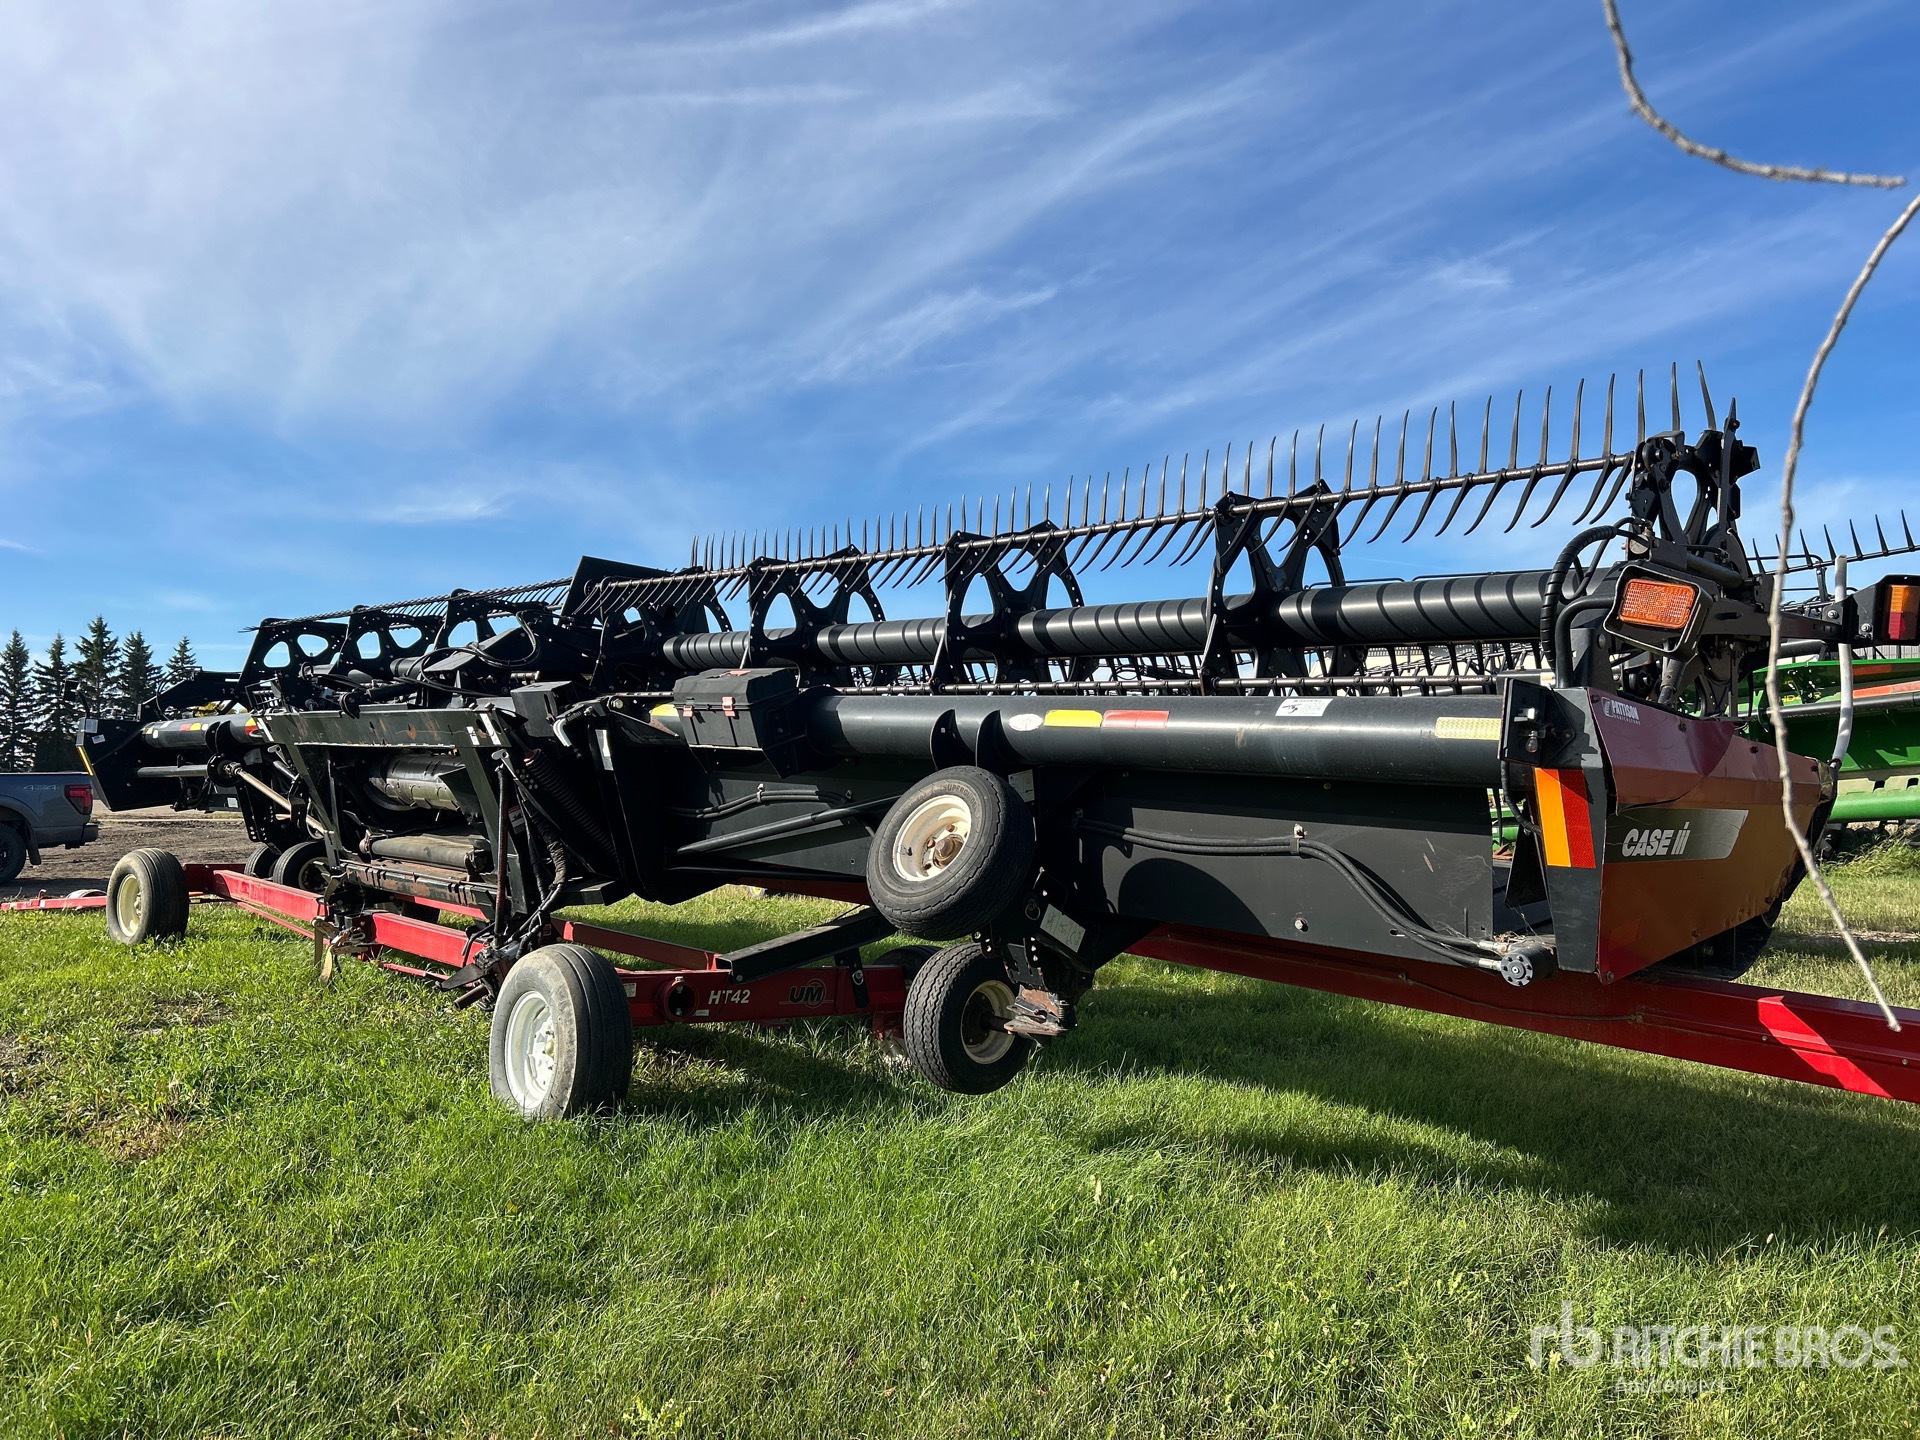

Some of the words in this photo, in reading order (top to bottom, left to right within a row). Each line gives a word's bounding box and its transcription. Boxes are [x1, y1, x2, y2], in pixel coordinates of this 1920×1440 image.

[1611, 699, 1640, 720] PATTISON
[1621, 828, 1675, 857] CASE
[707, 989, 751, 1005] HT42
[788, 985, 825, 1003] UM
